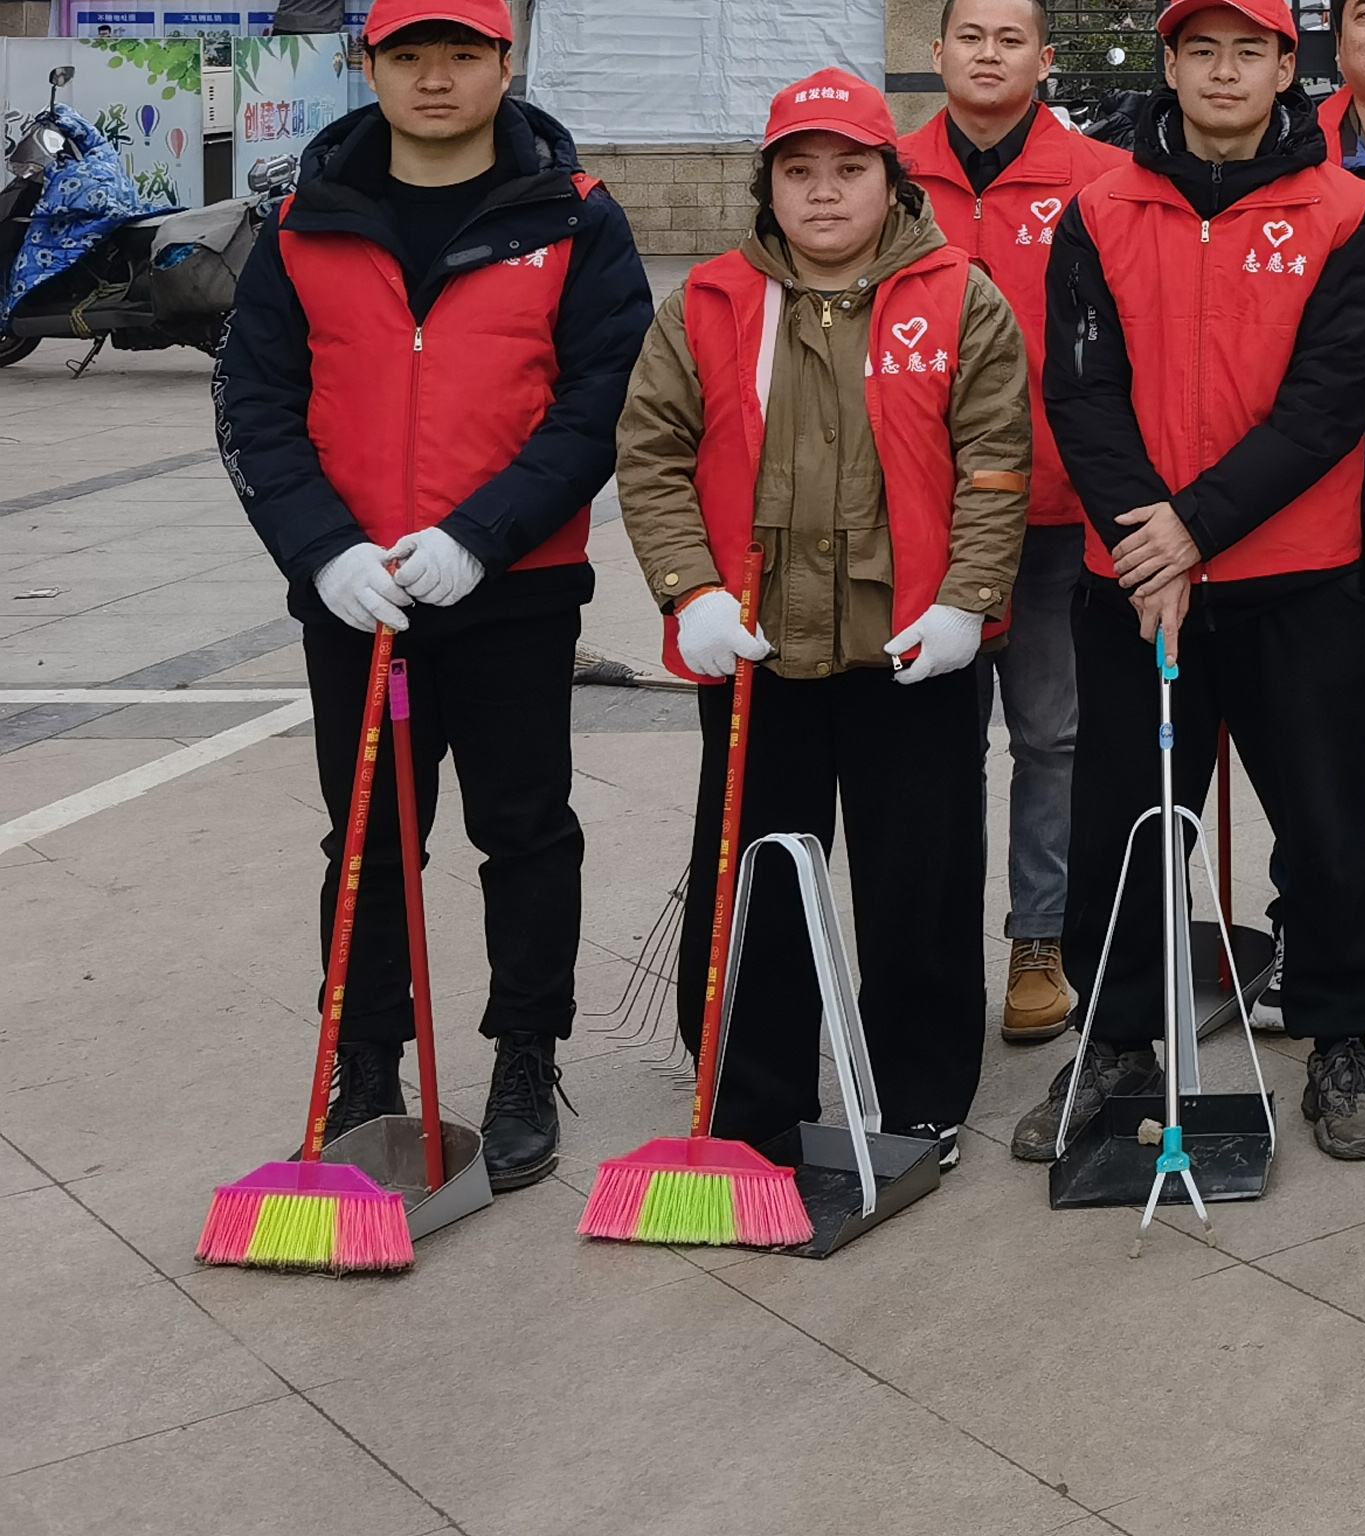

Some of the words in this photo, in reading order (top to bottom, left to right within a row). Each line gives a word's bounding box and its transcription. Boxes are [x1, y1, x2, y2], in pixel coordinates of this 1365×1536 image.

[795, 87, 849, 103] 建发检测
[1015, 224, 1053, 245] 志愿
[1242, 251, 1307, 276] 志愿者
[881, 348, 948, 373] 志愿者
[364, 727, 380, 762] 福源
[346, 855, 362, 890] 福源
[330, 985, 345, 1020] 福源
